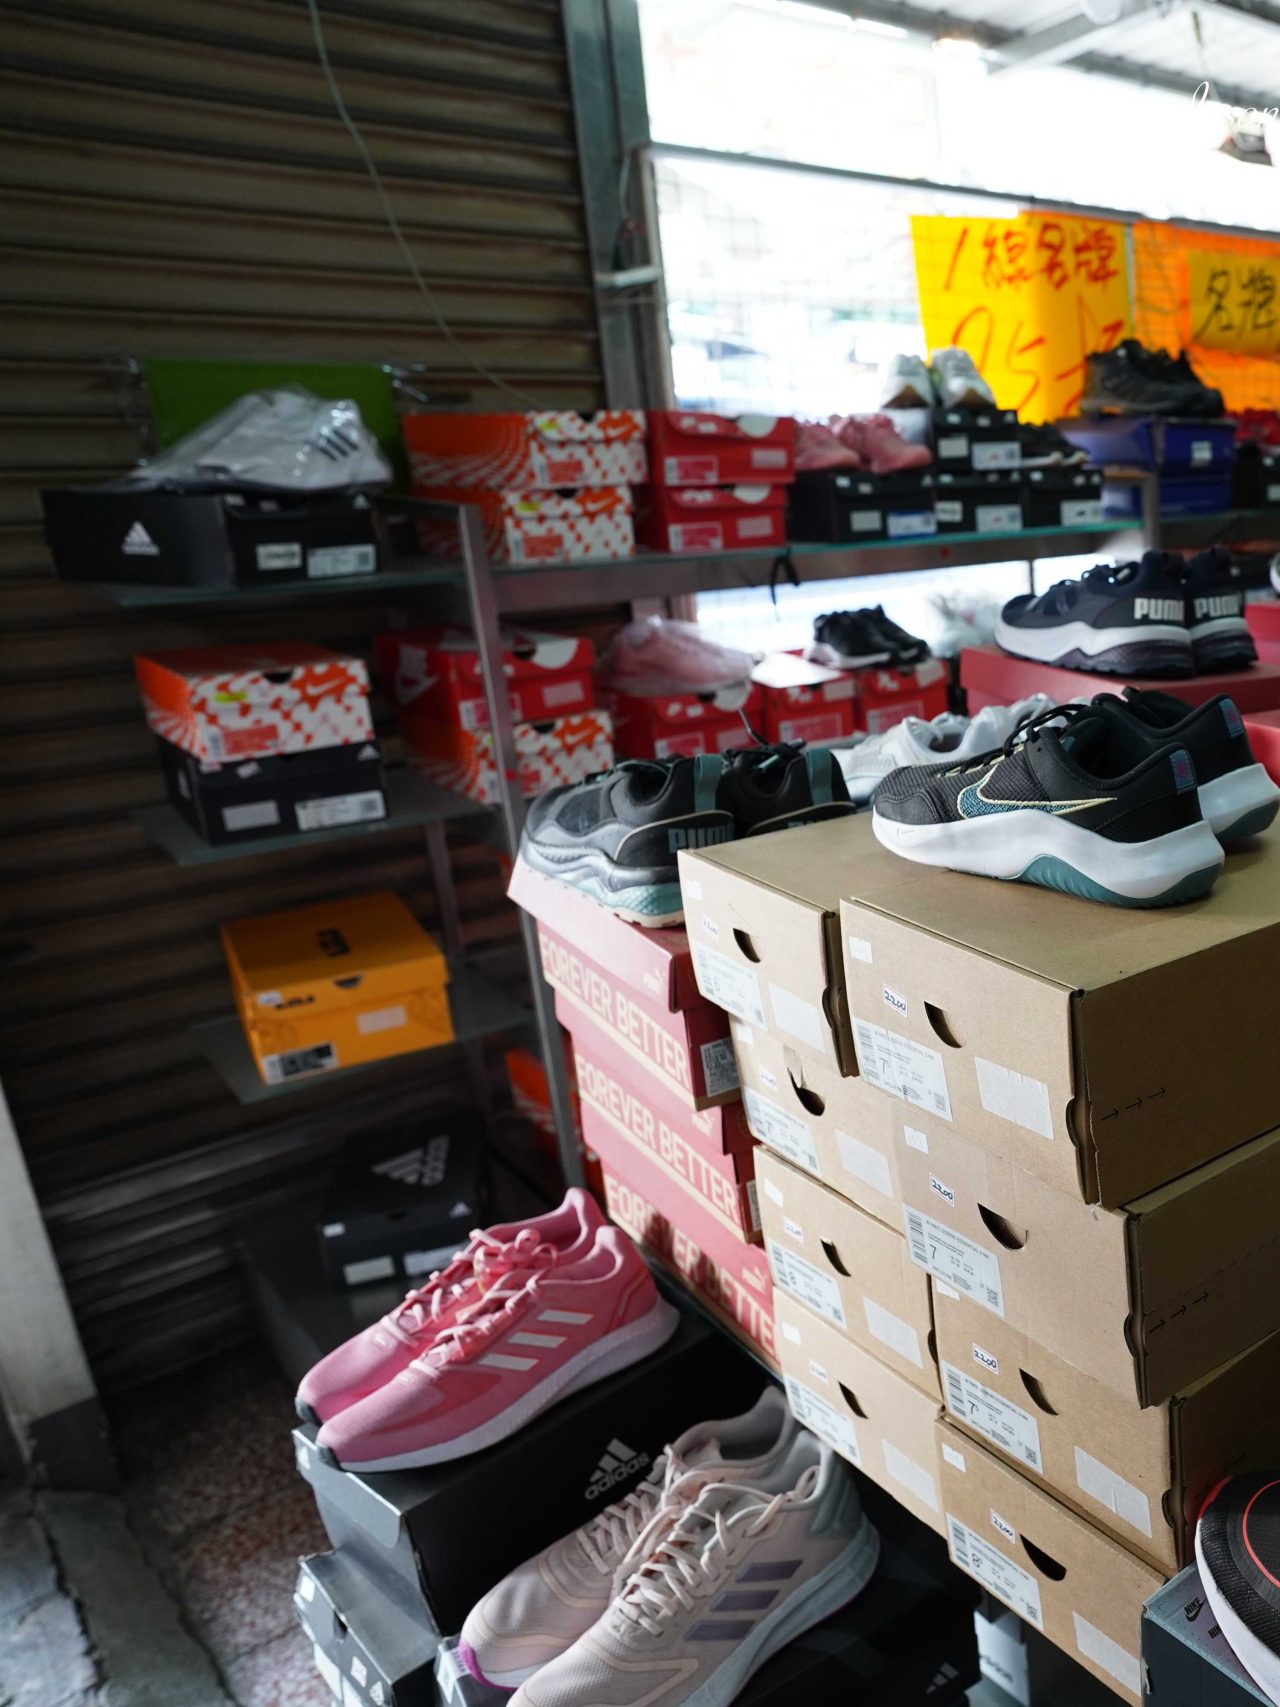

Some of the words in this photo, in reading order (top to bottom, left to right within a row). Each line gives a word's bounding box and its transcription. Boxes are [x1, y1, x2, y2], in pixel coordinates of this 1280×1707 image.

[538, 932, 613, 1022] FOREVER
[617, 991, 690, 1087] BETTER
[884, 990, 906, 1012] 2200
[575, 1053, 655, 1147] FOREVER
[658, 1120, 741, 1227] BETTER
[932, 1179, 953, 1200] 2200
[974, 1350, 997, 1369] 2200
[584, 1452, 651, 1500] adidas
[1183, 1597, 1201, 1615] NIKE
